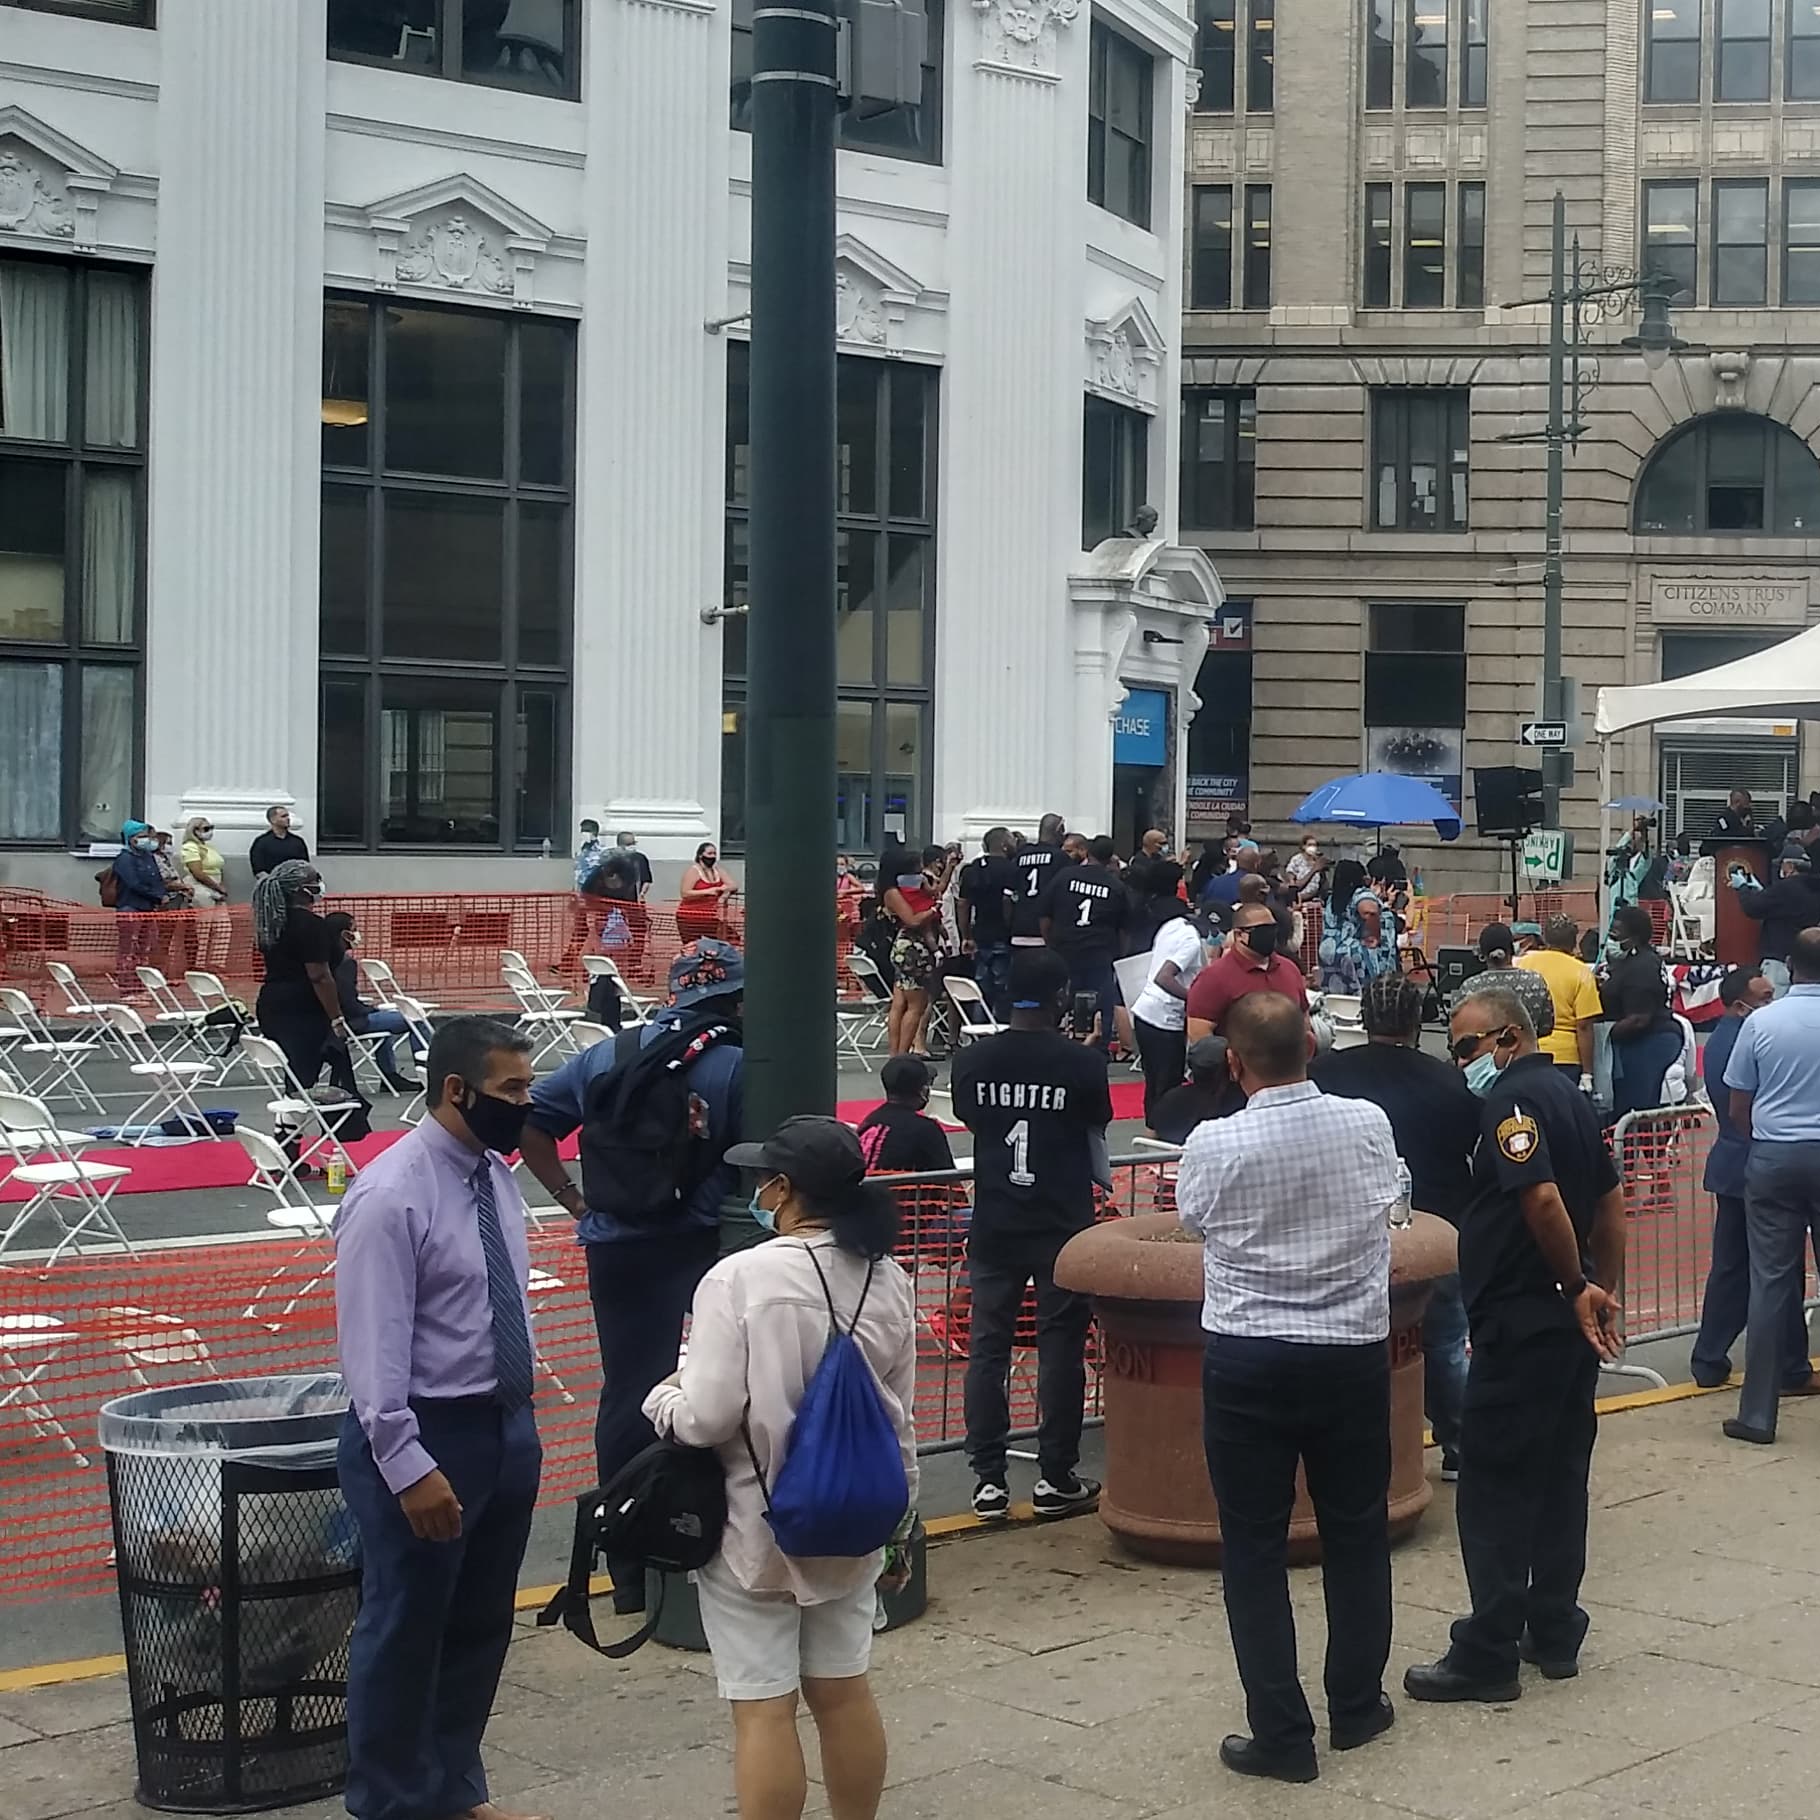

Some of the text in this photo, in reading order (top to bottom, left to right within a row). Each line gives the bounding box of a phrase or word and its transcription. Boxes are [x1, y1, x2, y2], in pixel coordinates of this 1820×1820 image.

[1664, 587, 1793, 602] CITIZENS TRUST
[1689, 601, 1771, 616] COMPANY
[1115, 717, 1151, 737] CHASE
[1535, 730, 1561, 739] ONE WAY
[1223, 778, 1239, 787] CITY
[1019, 853, 1052, 867] FIGHTER
[1026, 868, 1039, 897] 1
[1069, 880, 1110, 899] FIGHTER
[1076, 898, 1092, 927] 1
[976, 1081, 1067, 1111] FIGHTER
[1004, 1119, 1036, 1187] 1
